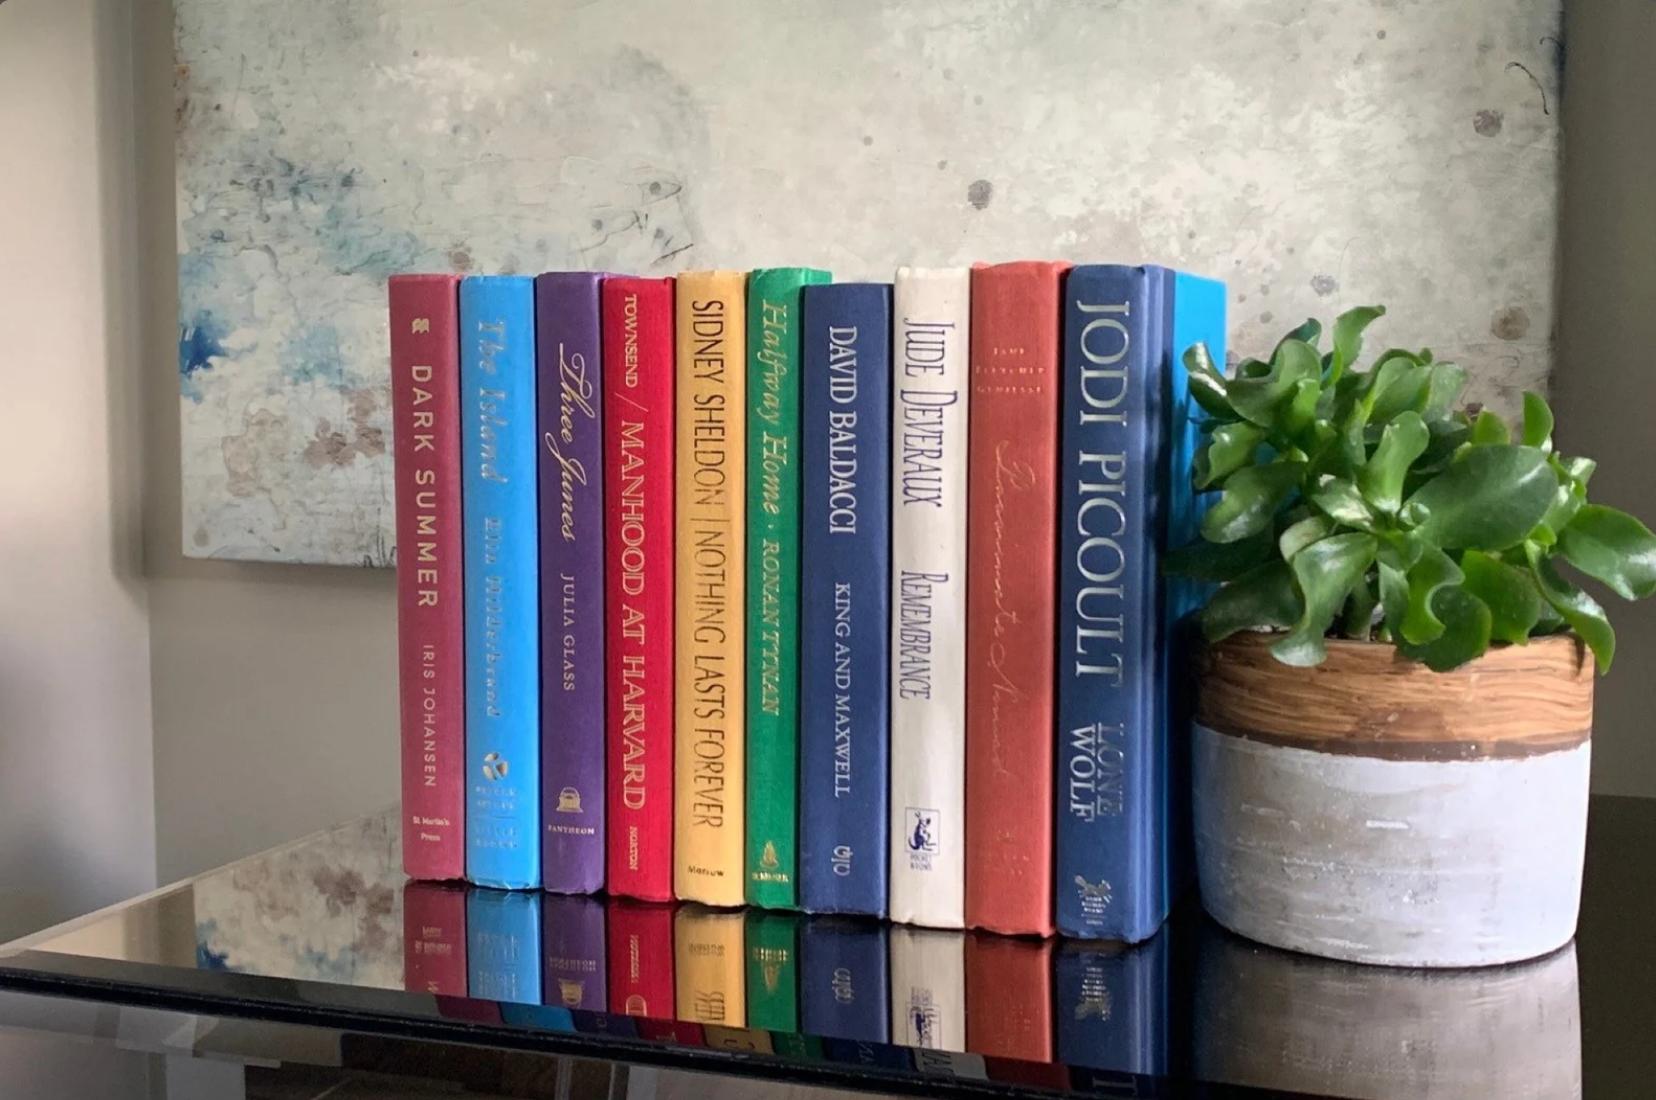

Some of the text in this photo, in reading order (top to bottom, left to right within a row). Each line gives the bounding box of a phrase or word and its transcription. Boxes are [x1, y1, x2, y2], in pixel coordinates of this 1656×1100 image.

[477, 318, 508, 483] The Island
[624, 294, 637, 388] TOWNSEND
[692, 301, 725, 505] SIDNEY SHELDON
[758, 300, 787, 514] Halfway Home
[900, 317, 957, 508] JUDE DEVERAUX
[411, 365, 438, 607] DARK SUMMER
[545, 343, 594, 542] Three Junes
[621, 420, 644, 595] MANHOOD
[828, 326, 857, 533] DAVID BALDACCI
[1074, 300, 1130, 686] JODI PICOULT
[562, 573, 576, 691] JULIA GLASS
[623, 603, 644, 644] AT
[692, 530, 725, 827] NOTHING LASTS FOREVER
[762, 539, 780, 715] RONAN TYNAN
[834, 583, 850, 798] KING AND MAXWELL
[900, 570, 949, 700] REMEMBRANCE
[423, 645, 437, 787] IRIS JOHANSEN
[623, 655, 644, 809] HARVARD
[1069, 723, 1095, 822] WOLF
[1096, 722, 1125, 818] LONE
[548, 825, 595, 836] PANTHEON
